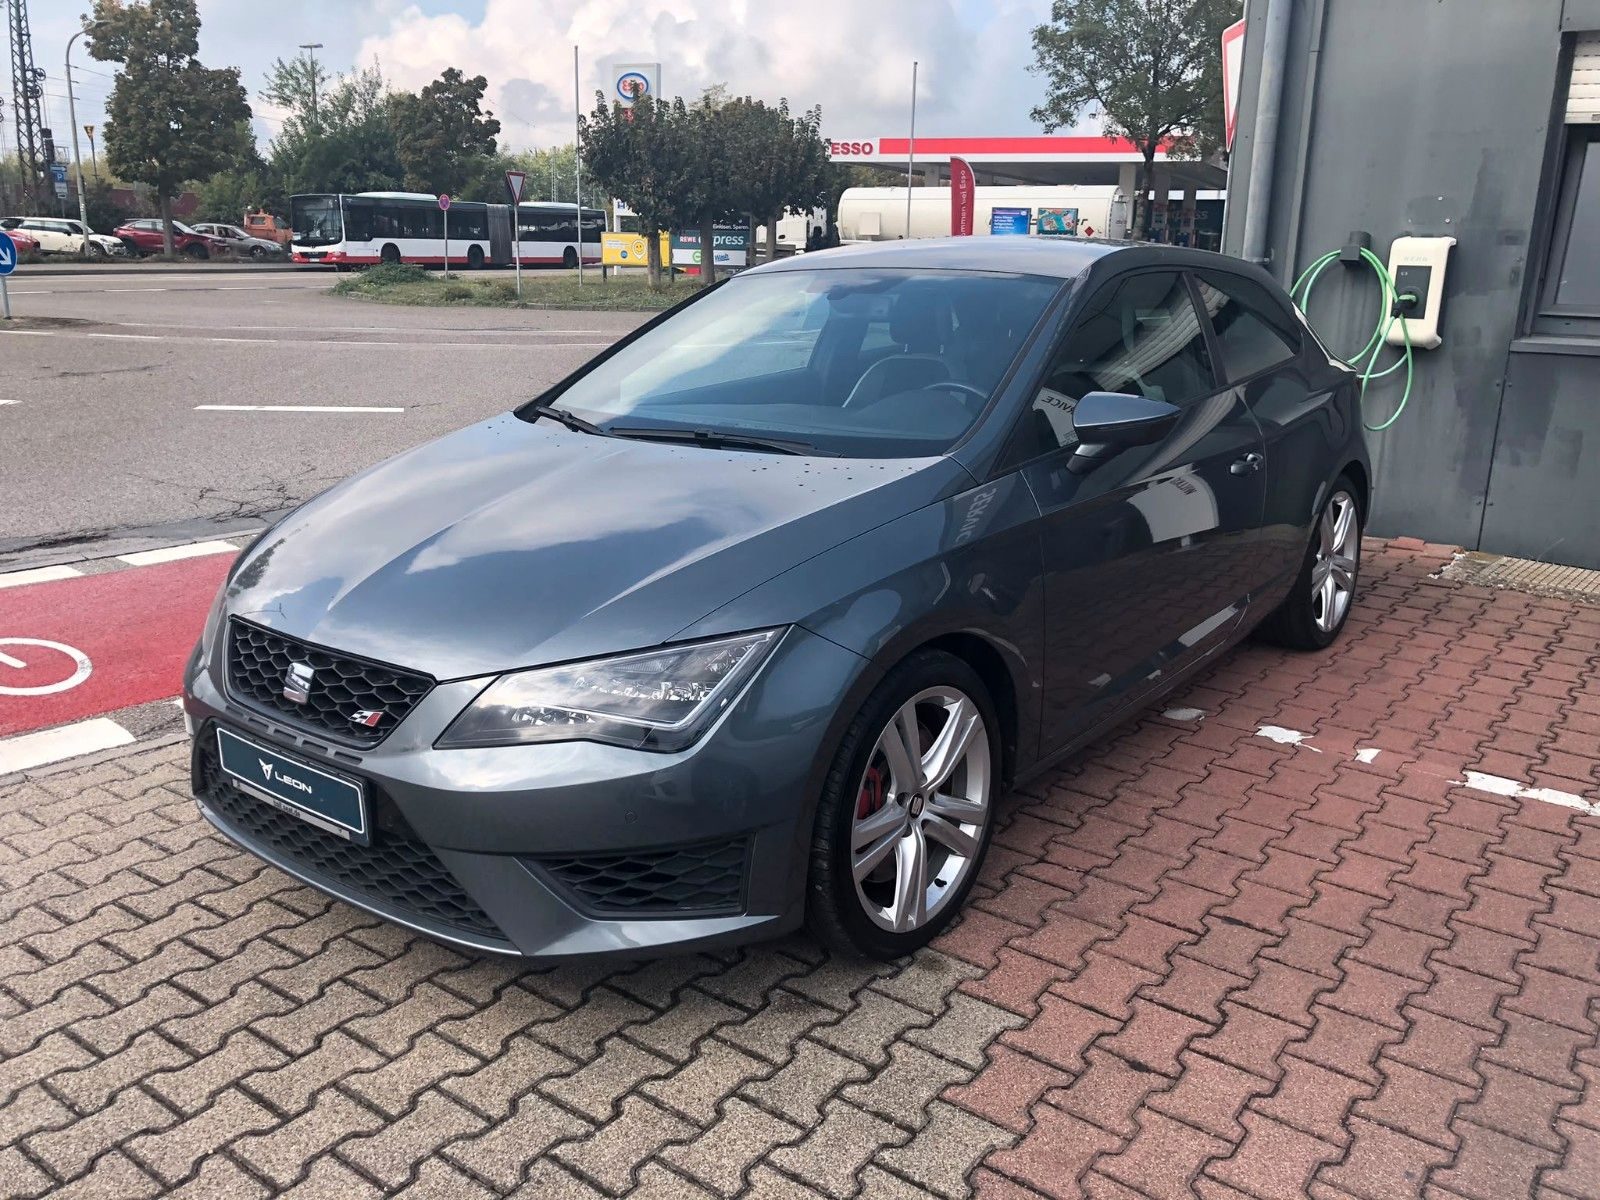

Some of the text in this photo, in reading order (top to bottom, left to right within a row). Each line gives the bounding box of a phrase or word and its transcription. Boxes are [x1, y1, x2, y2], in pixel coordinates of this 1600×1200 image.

[622, 80, 645, 93] Eso
[831, 142, 874, 155] ESSO
[275, 771, 313, 795] LEON
